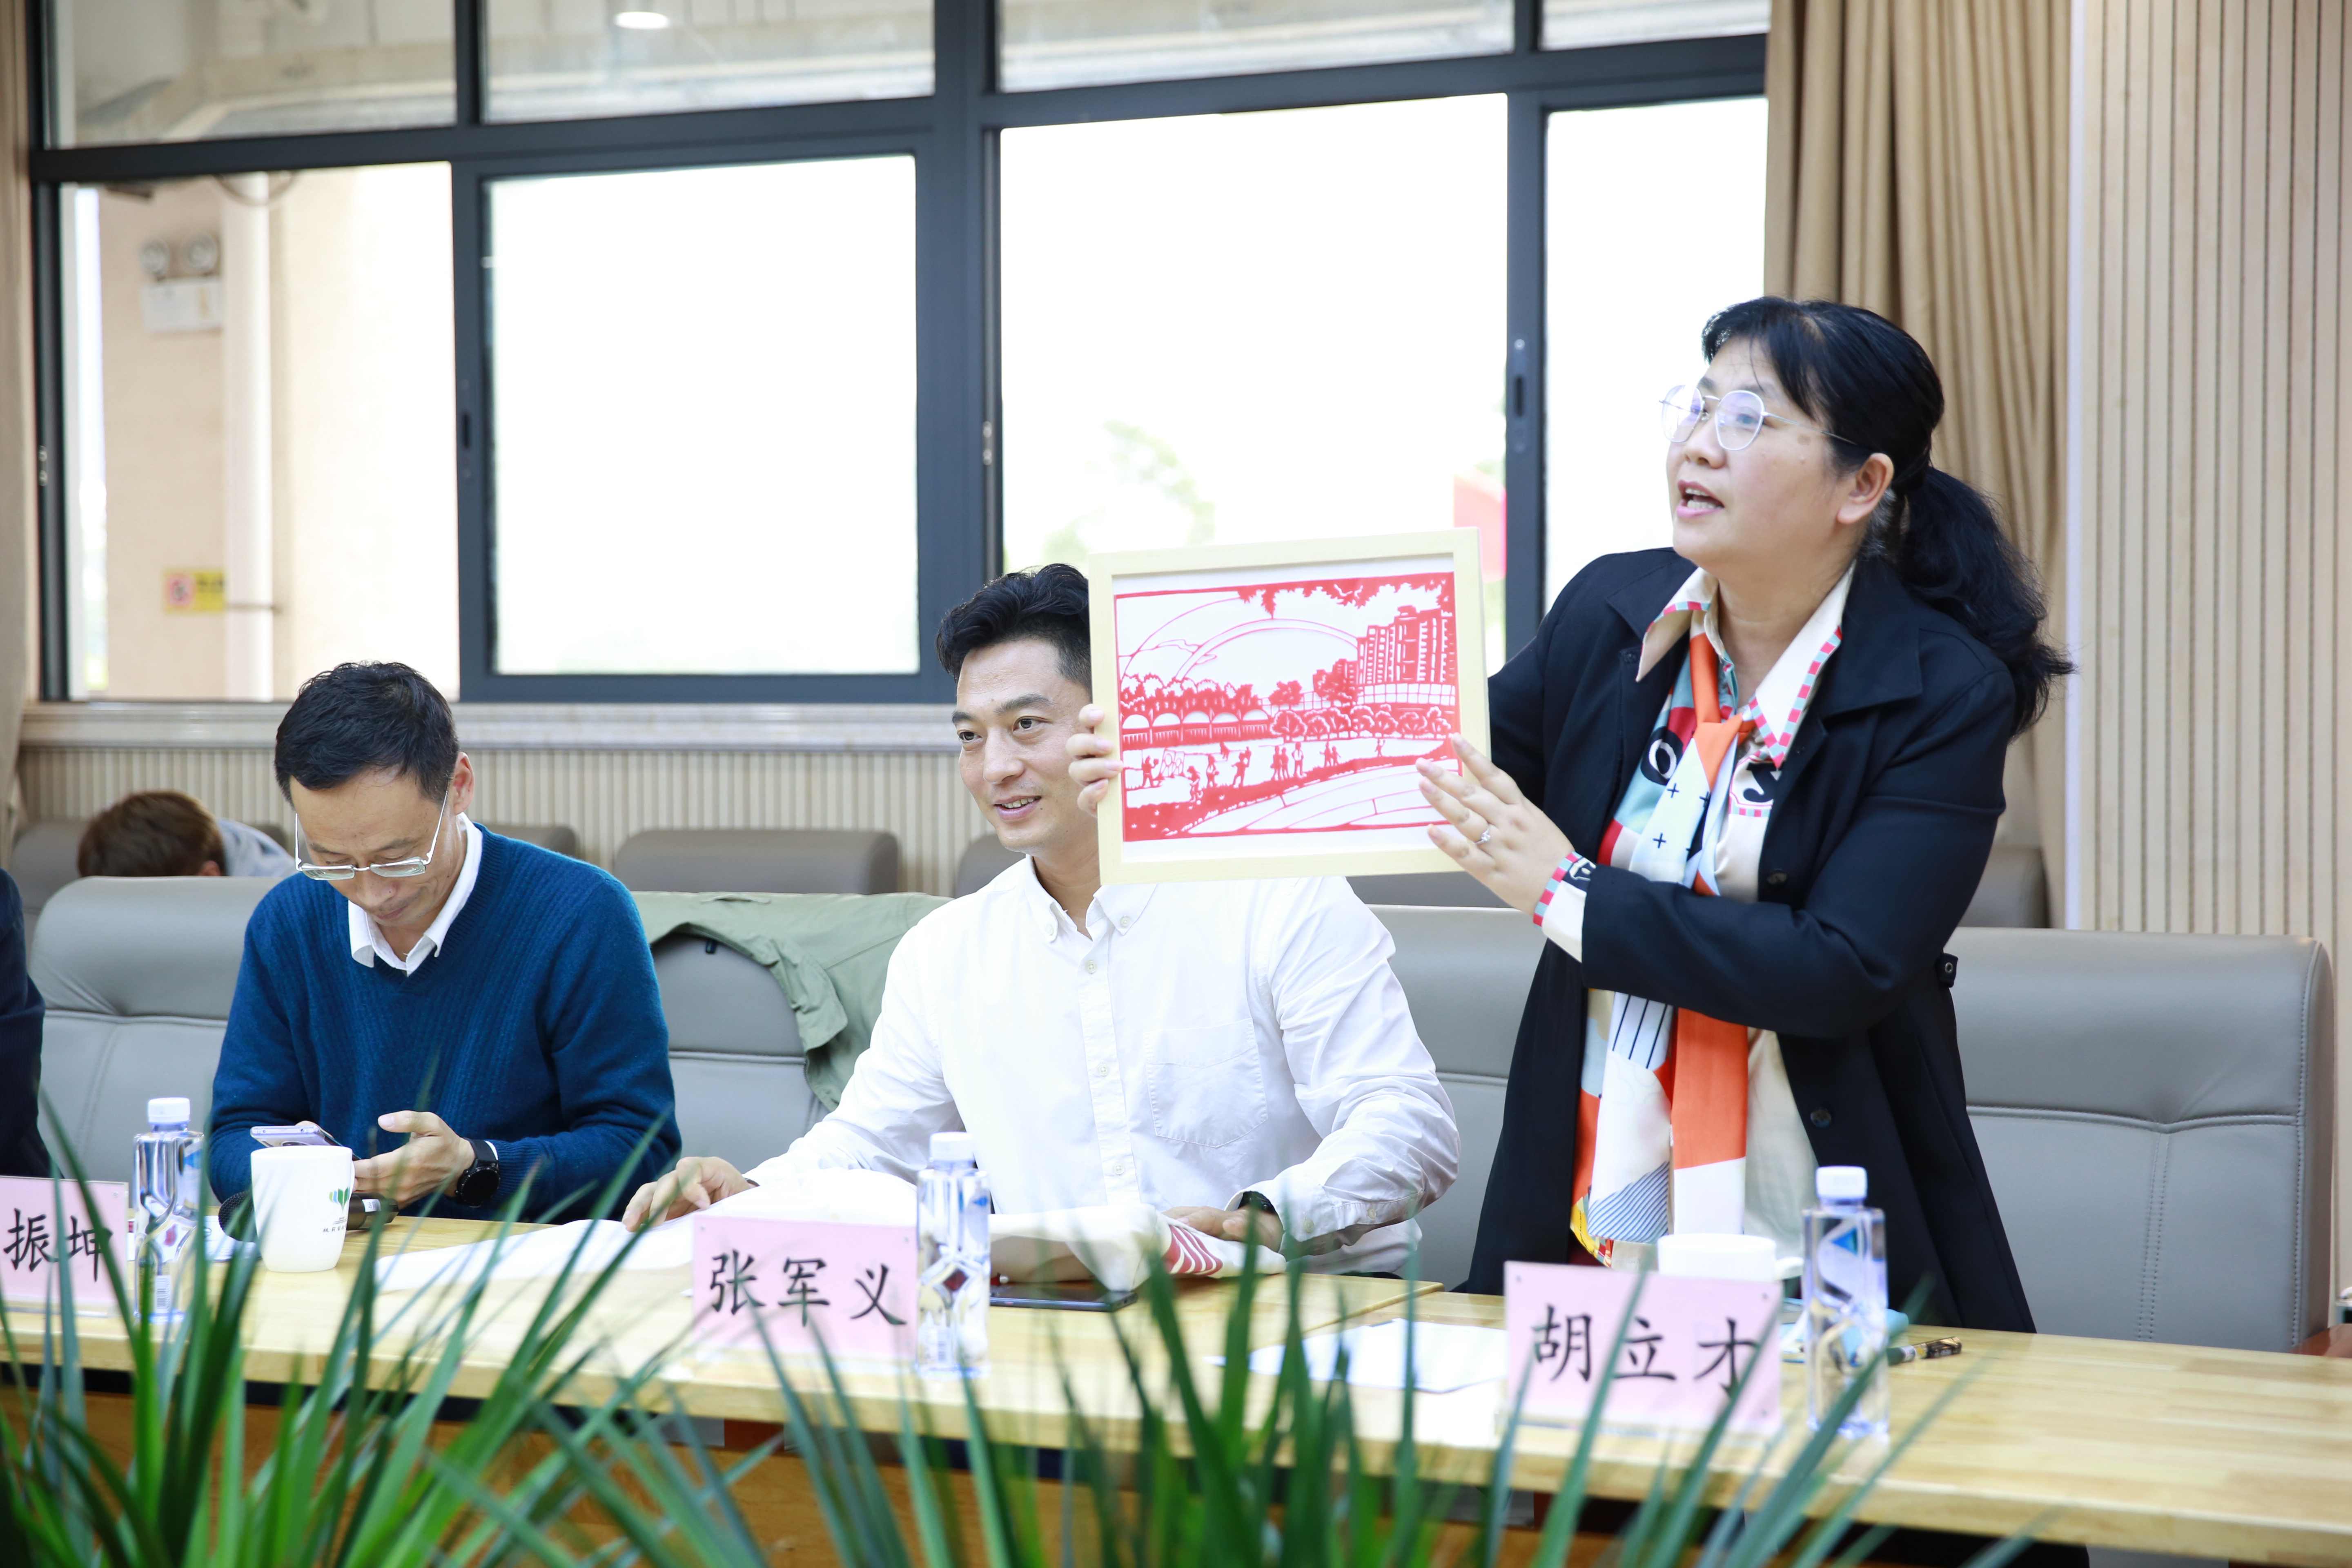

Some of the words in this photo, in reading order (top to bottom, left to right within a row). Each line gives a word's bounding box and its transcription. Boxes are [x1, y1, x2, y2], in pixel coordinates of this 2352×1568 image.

[3, 1208, 113, 1282] 振坤
[710, 1249, 906, 1327] 张军义
[1531, 1304, 1761, 1397] 胡立才
